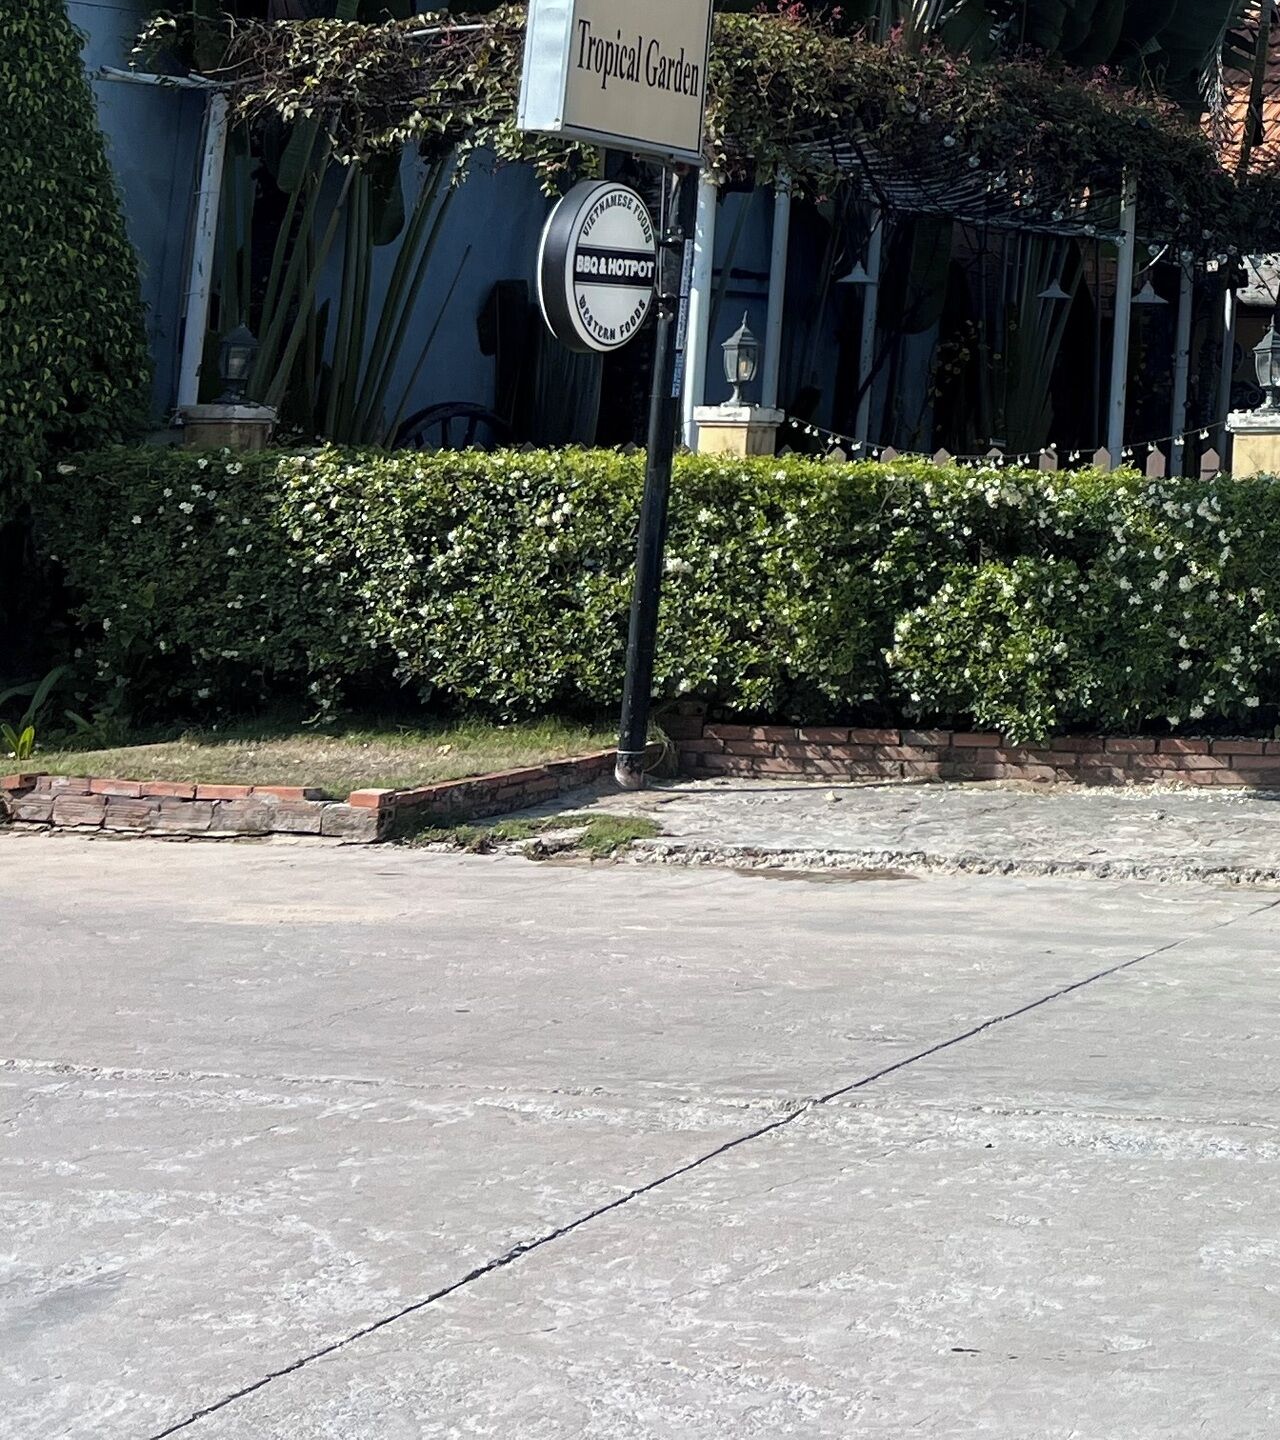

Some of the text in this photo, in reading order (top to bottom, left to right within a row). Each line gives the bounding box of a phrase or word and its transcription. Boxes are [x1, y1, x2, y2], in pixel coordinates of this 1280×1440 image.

[577, 18, 700, 97] Tropical Garden
[582, 193, 653, 245] VIETNAMESE FOODS
[578, 293, 646, 341] WESTERN FOODS
